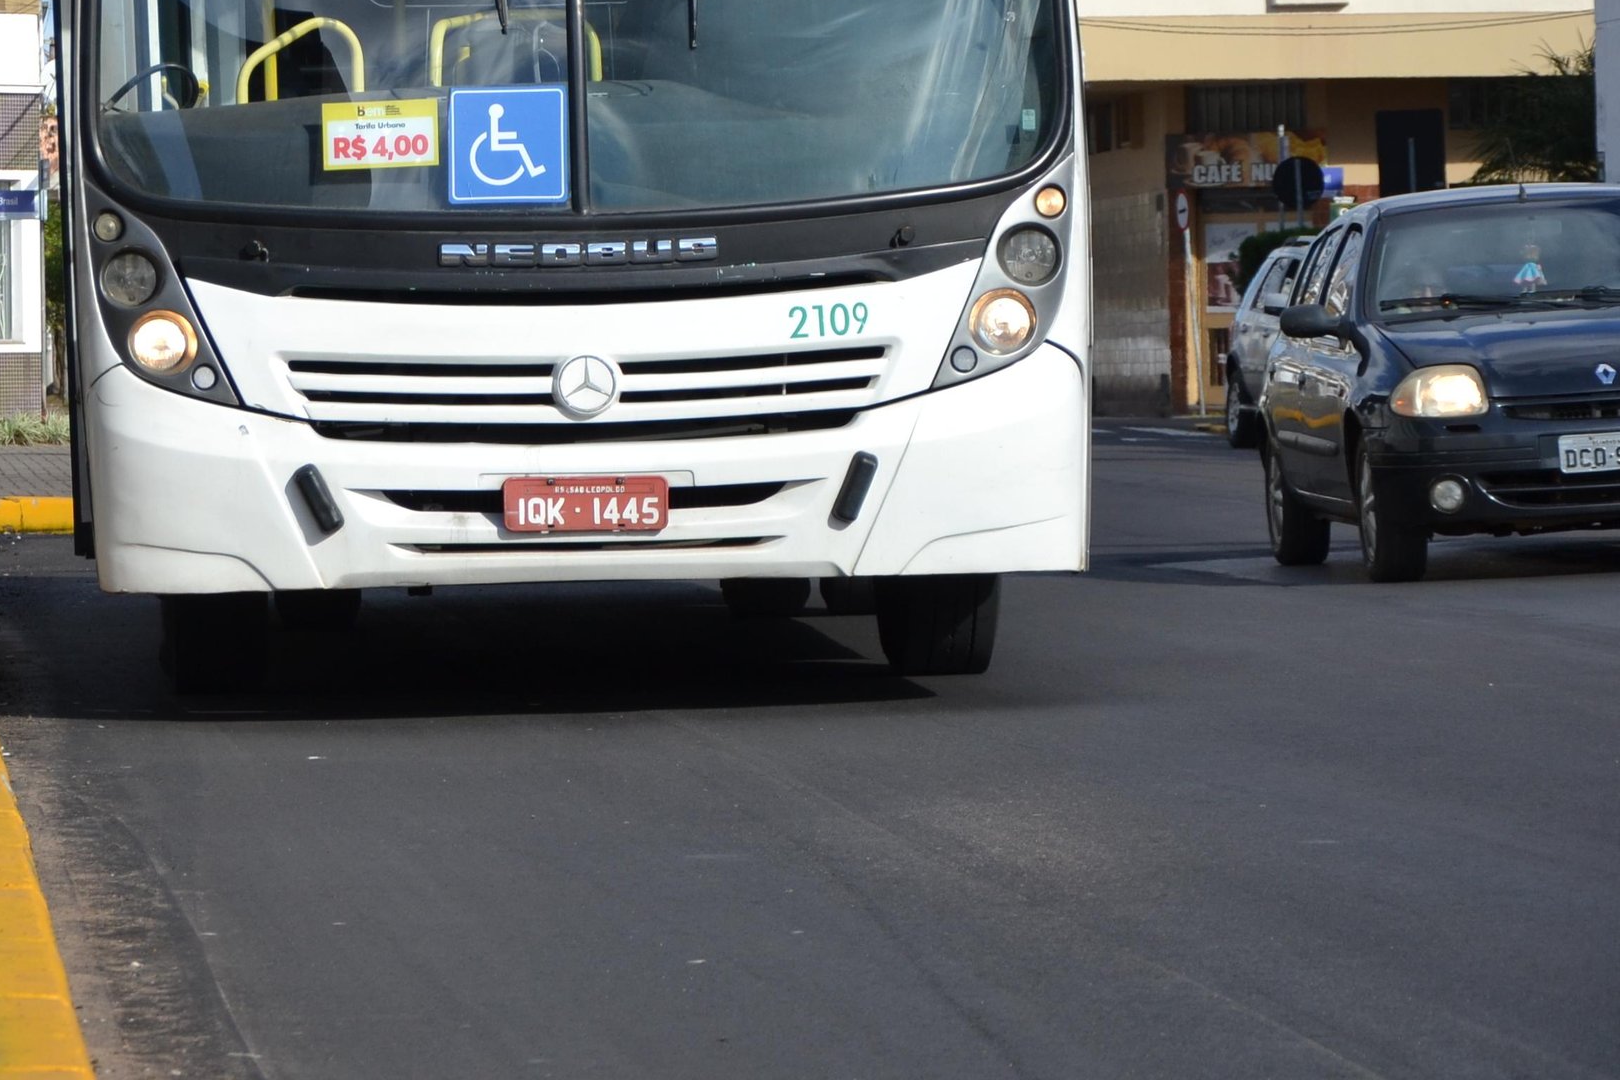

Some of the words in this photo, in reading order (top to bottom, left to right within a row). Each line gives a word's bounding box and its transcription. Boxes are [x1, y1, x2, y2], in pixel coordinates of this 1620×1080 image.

[333, 134, 367, 161] R$
[371, 134, 429, 161] 4,00
[1192, 161, 1243, 184] CAFÉ
[1251, 162, 1277, 182] NU
[441, 237, 718, 267] NEOBUS
[788, 302, 868, 339] 2109
[518, 497, 565, 526] IQK
[593, 497, 660, 525] 1445
